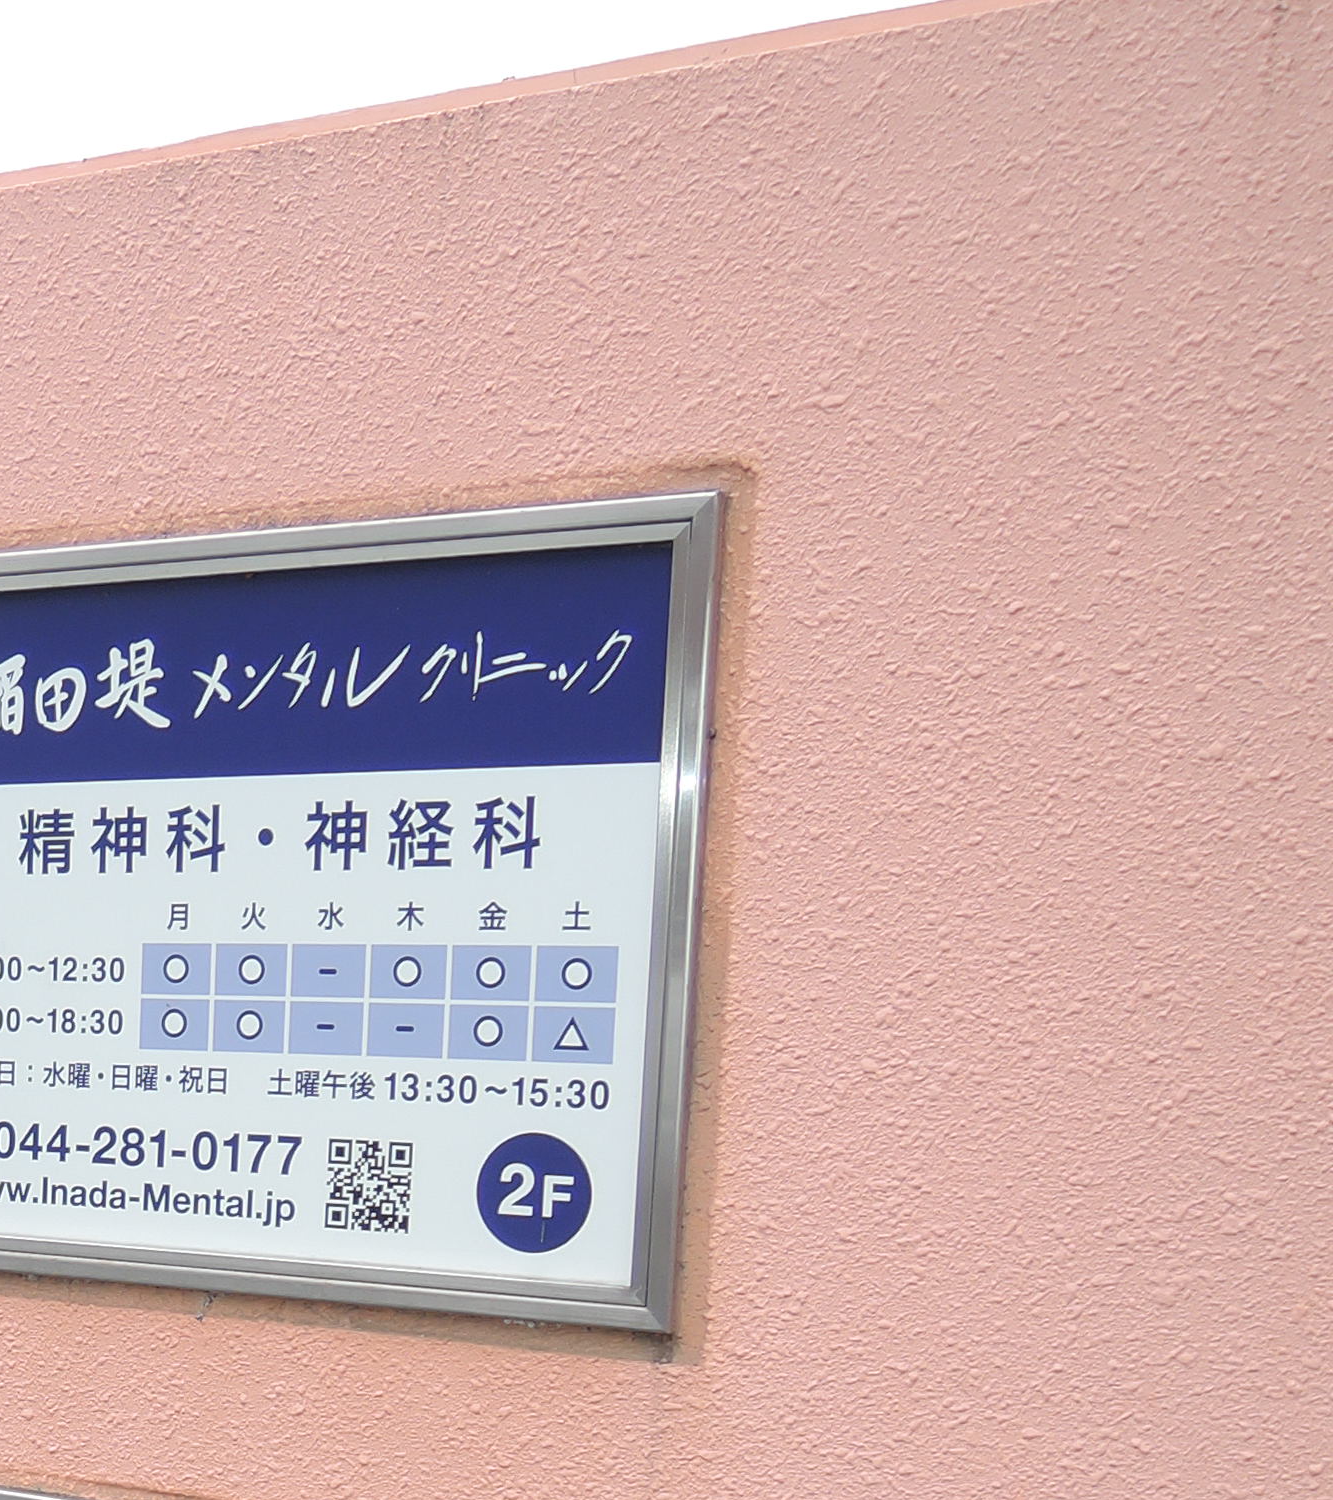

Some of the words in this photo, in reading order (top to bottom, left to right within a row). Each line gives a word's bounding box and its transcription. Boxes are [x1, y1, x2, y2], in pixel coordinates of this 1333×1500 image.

[191, 641, 413, 720] メンタル
[419, 628, 633, 704] クリニック
[19, 796, 542, 875] 精神科・神経科
[166, 903, 190, 931] 月
[240, 901, 267, 930] 火
[318, 902, 345, 930] 水
[397, 901, 425, 930] 木
[478, 901, 508, 932] 金
[562, 901, 591, 932] 土
[497, 1162, 576, 1218] 2F
